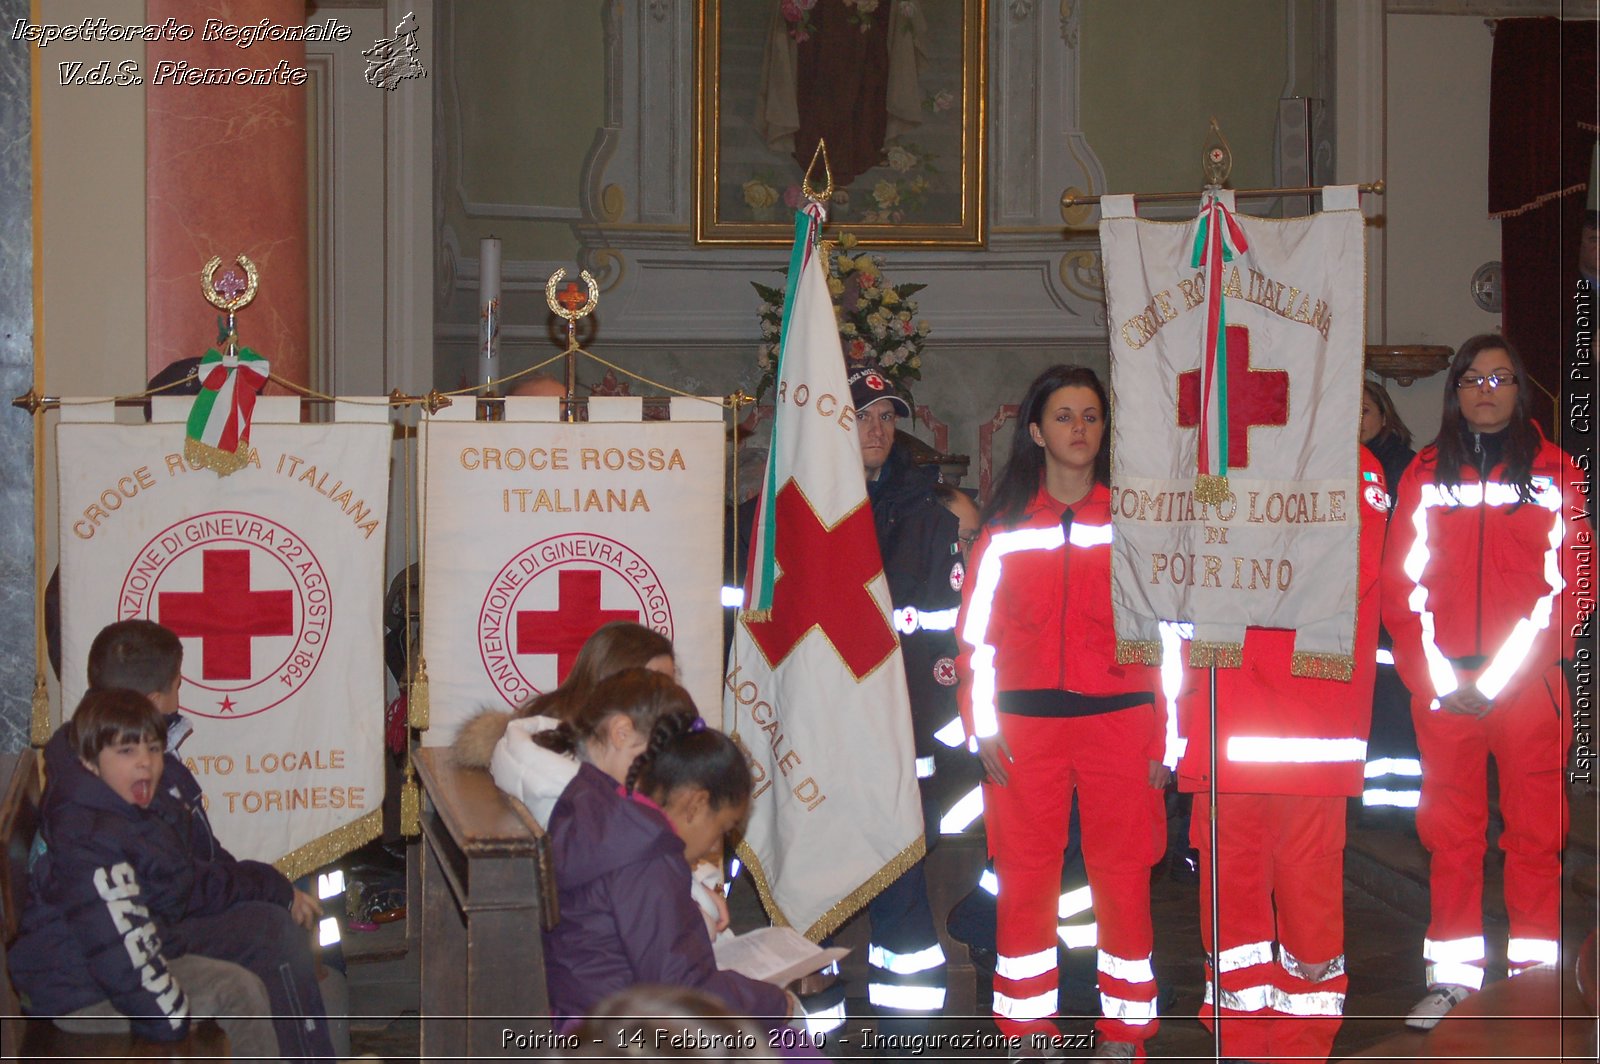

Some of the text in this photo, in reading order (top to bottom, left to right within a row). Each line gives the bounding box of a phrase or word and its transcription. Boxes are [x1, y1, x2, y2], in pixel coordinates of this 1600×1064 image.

[1177, 264, 1244, 312] ROA
[1245, 267, 1332, 342] ITALIANA
[779, 380, 857, 432] ROCE
[460, 447, 686, 471] CROCE ROSSA
[72, 465, 156, 541] CROCE
[276, 453, 380, 539] ITALIANA
[502, 488, 650, 513] ITALIANA
[1247, 490, 1346, 523] LOCALE
[161, 533, 184, 556] DI
[185, 518, 275, 546] GINEVRA
[1205, 526, 1229, 544] DI
[276, 537, 302, 561] 22
[1150, 552, 1293, 591] POIRINO
[297, 562, 328, 646] AGOSTO
[483, 540, 669, 704] CONVENZIONE DI GINEVRA 22 AGOS
[279, 649, 315, 688] 1864
[726, 665, 801, 777] LOCALE
[793, 776, 826, 812] DI
[246, 749, 345, 775] LOCALE
[223, 786, 365, 813] TORINESE
